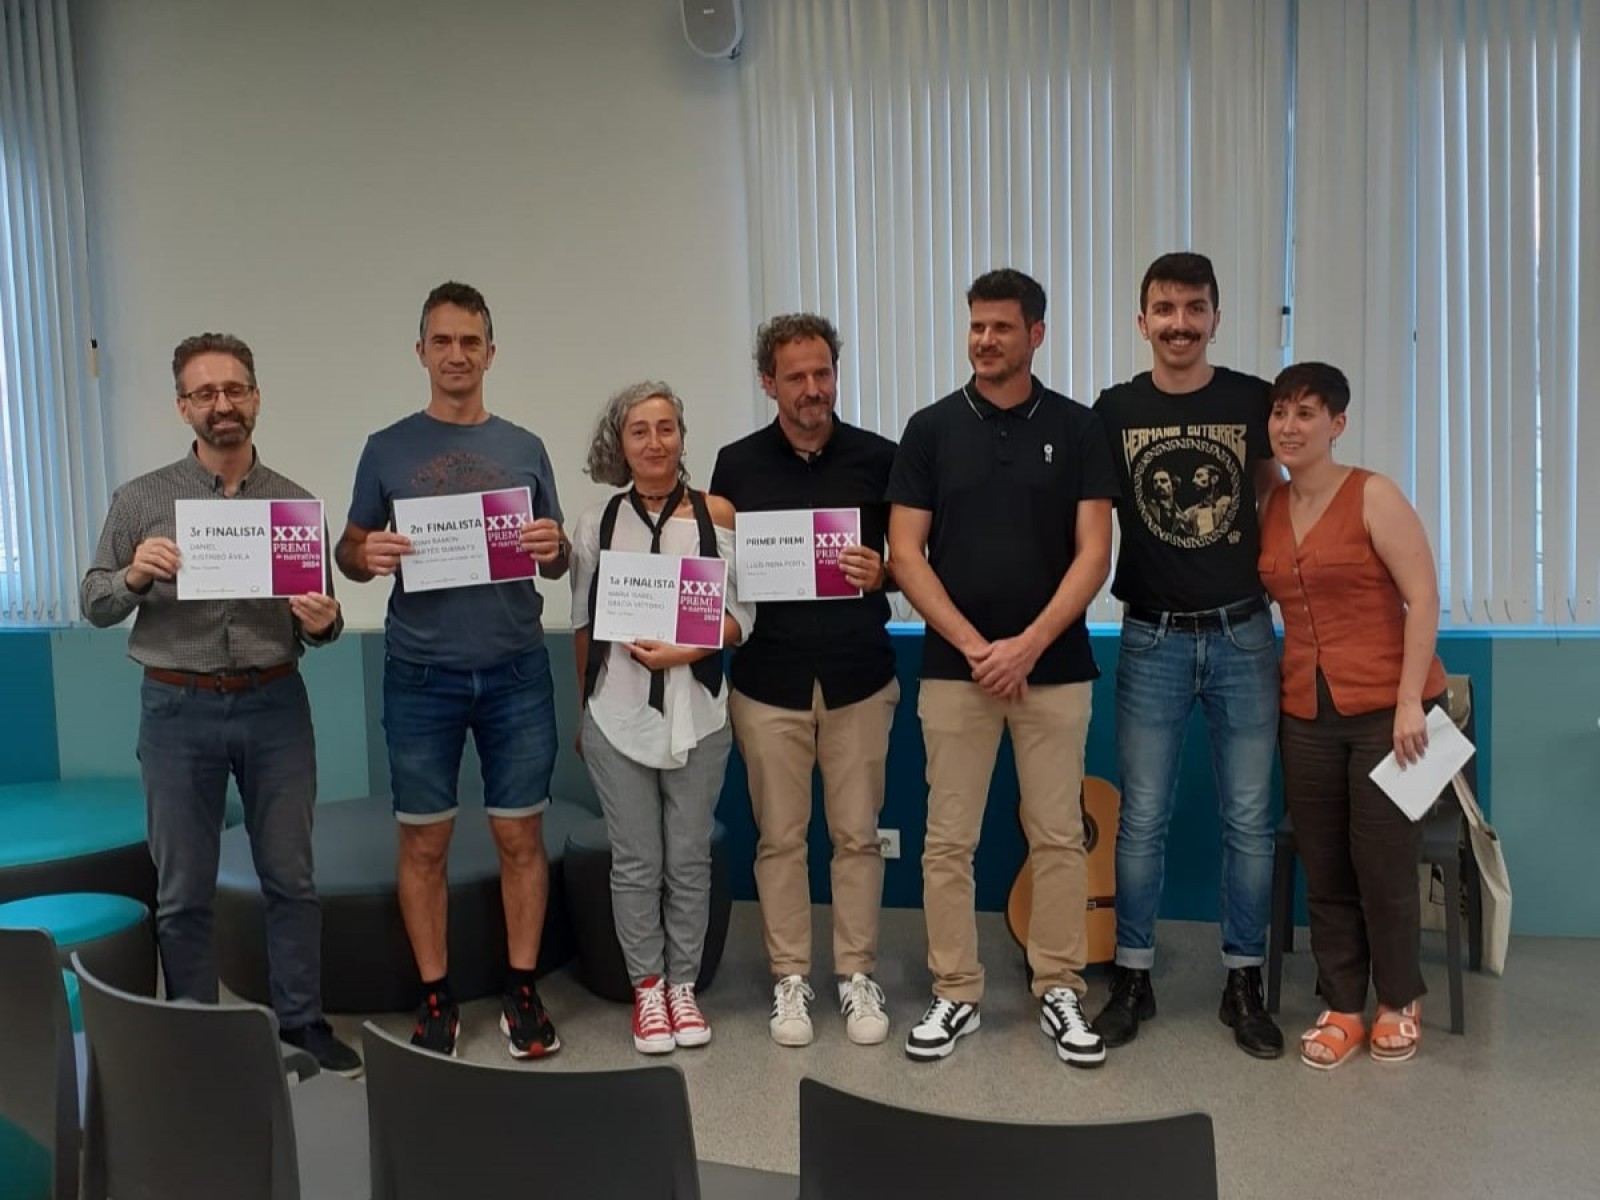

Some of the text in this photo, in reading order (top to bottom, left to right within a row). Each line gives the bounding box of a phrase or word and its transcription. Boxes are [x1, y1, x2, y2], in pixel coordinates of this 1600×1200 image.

[410, 518, 482, 534] 2n FINALISTA
[486, 512, 528, 531] XXX
[190, 526, 265, 537] 3r FINALISTA
[273, 526, 319, 541] XXX
[746, 536, 804, 546] PRIMER PREMI
[816, 533, 855, 548] XXX
[273, 543, 311, 553] PREMI
[623, 576, 675, 589] FINALISTA
[681, 580, 721, 596] XXX
[680, 596, 713, 607] PREMI
